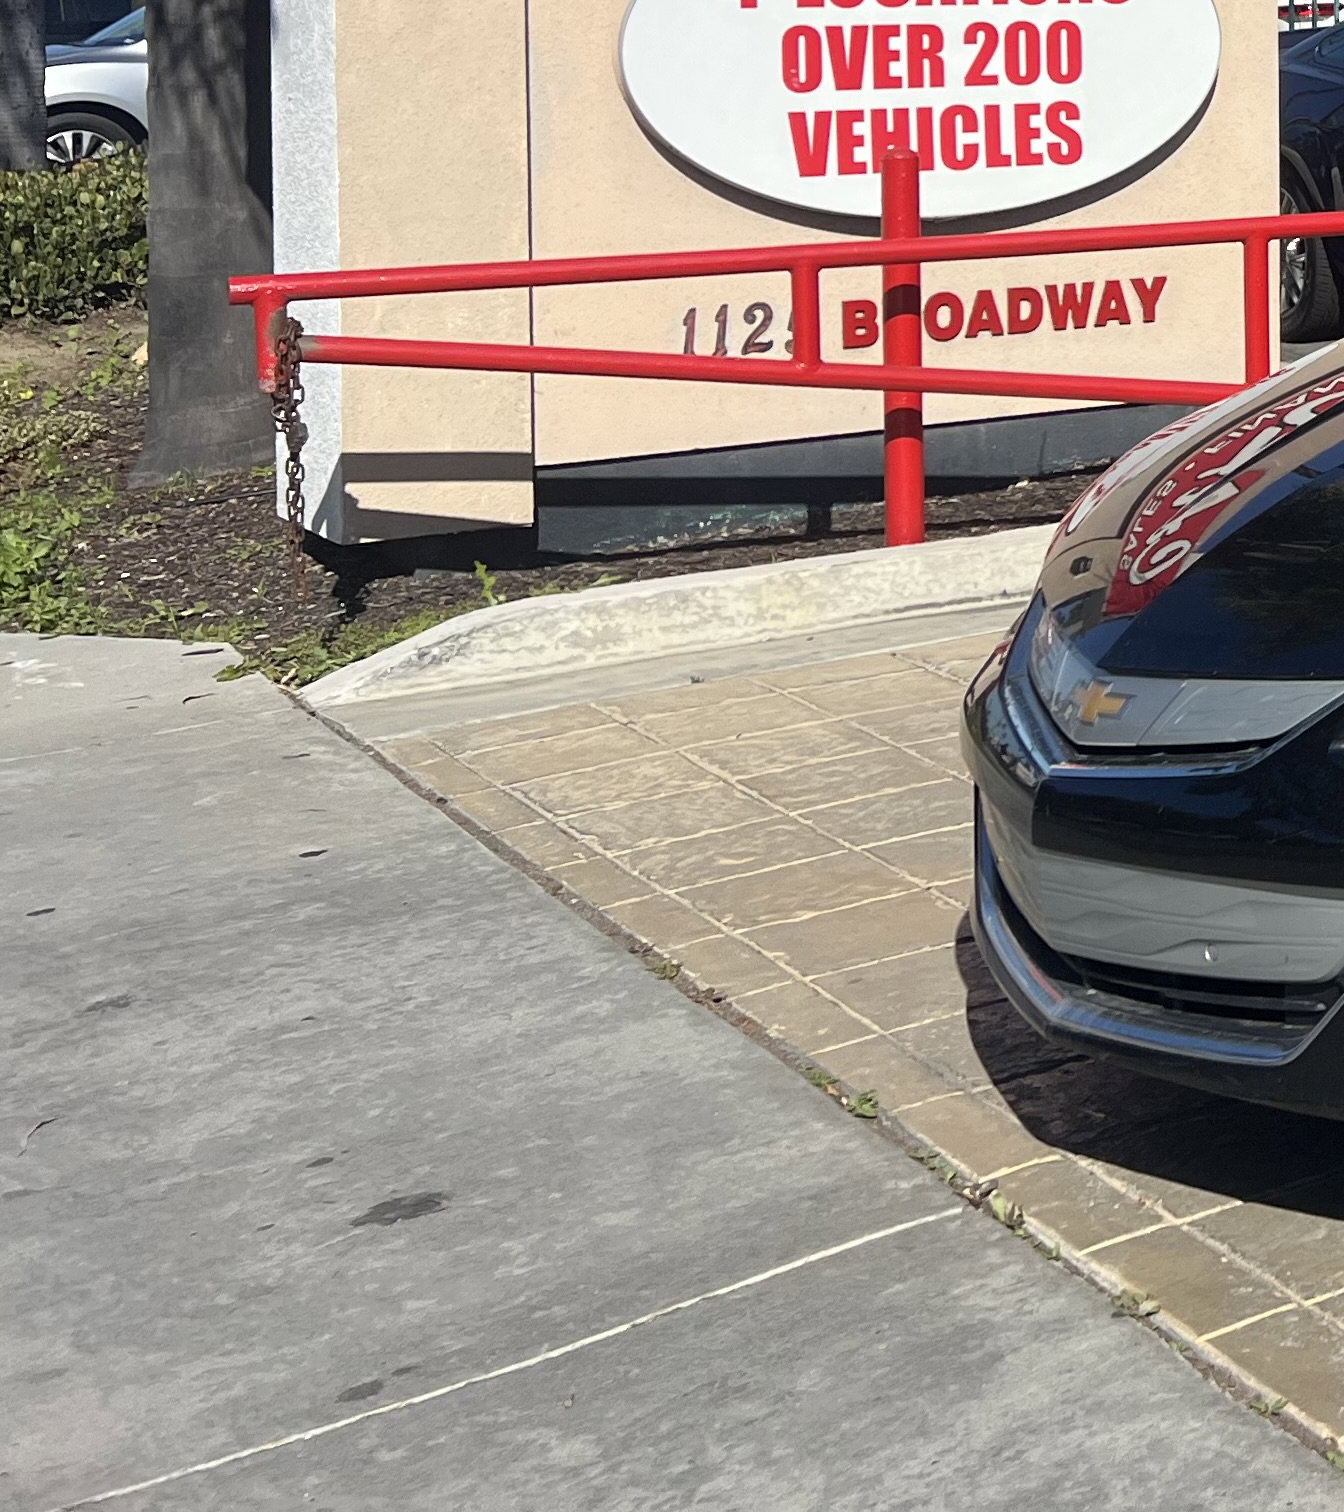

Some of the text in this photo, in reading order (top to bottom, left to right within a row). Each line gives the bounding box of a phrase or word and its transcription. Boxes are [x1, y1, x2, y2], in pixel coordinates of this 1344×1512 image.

[782, 19, 1083, 93] OVER 200
[788, 100, 1083, 177] VEHICLES
[683, 276, 1168, 356] 112 BOADWAY
